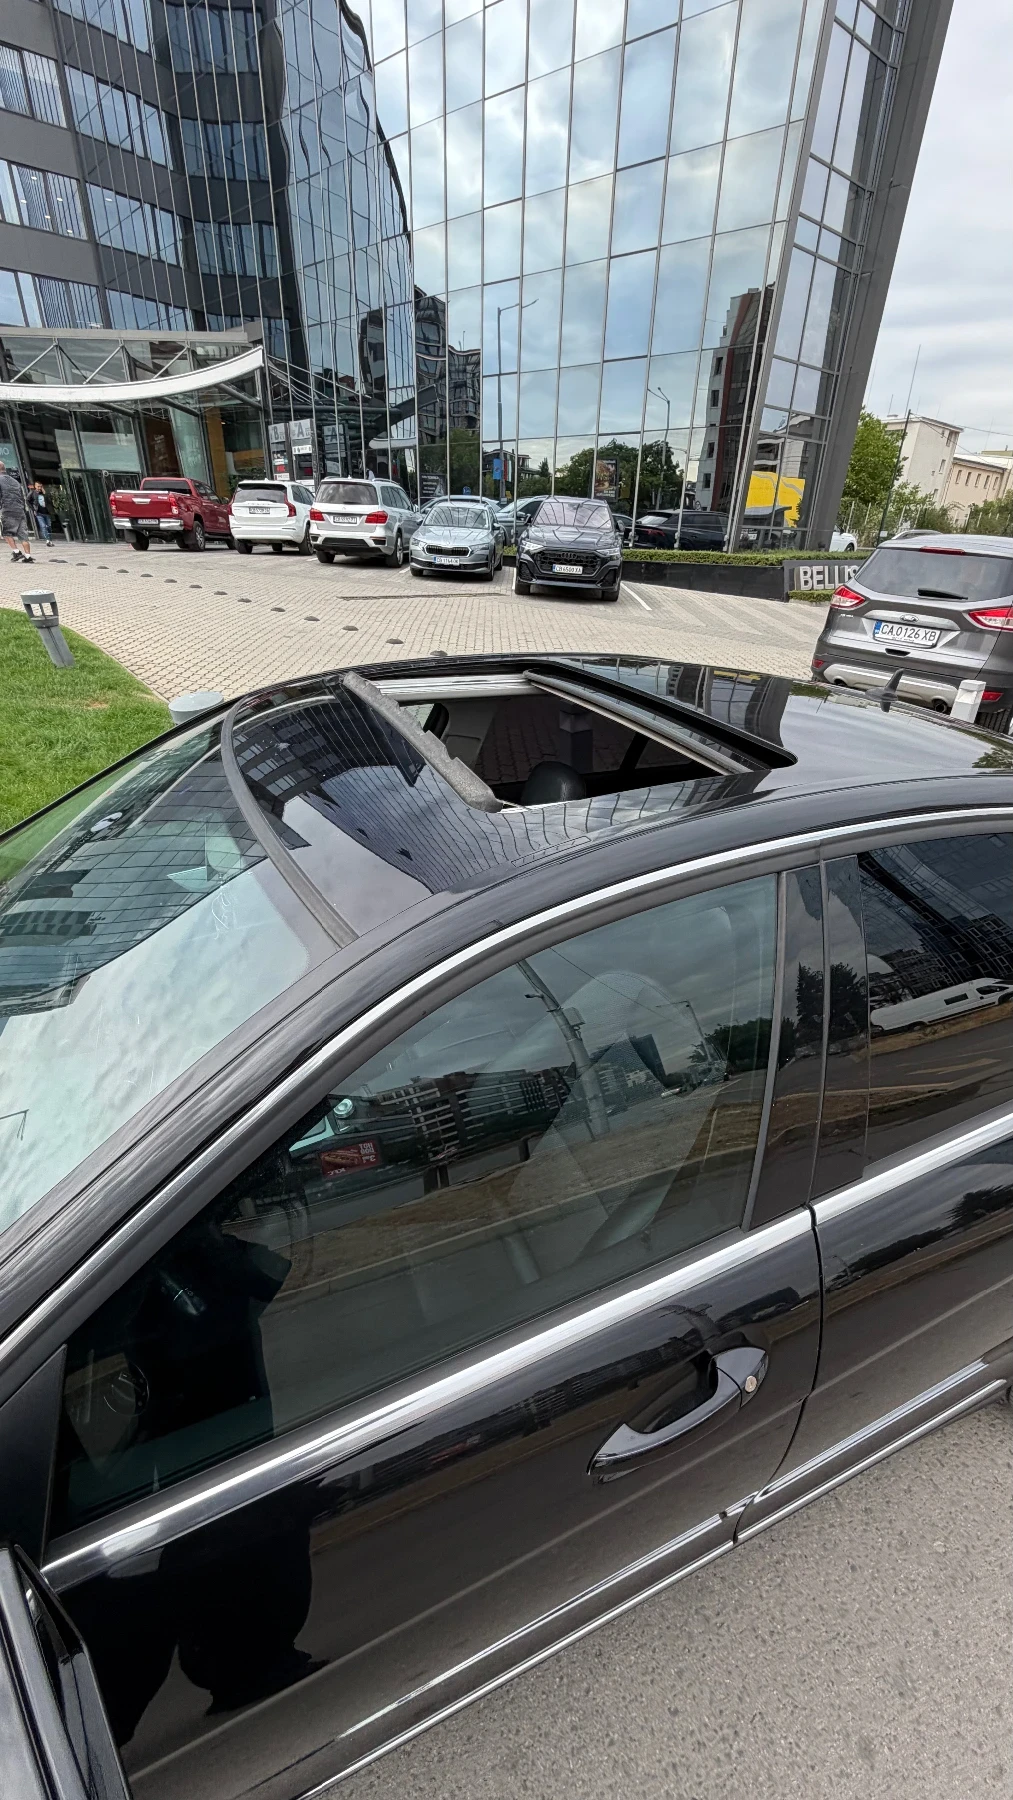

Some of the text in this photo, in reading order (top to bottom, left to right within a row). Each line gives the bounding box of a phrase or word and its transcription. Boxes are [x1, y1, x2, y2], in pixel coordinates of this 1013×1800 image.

[273, 425, 279, 440] B
[297, 422, 304, 438] A
[896, 627, 920, 639] 0126
[921, 629, 937, 642] XB
